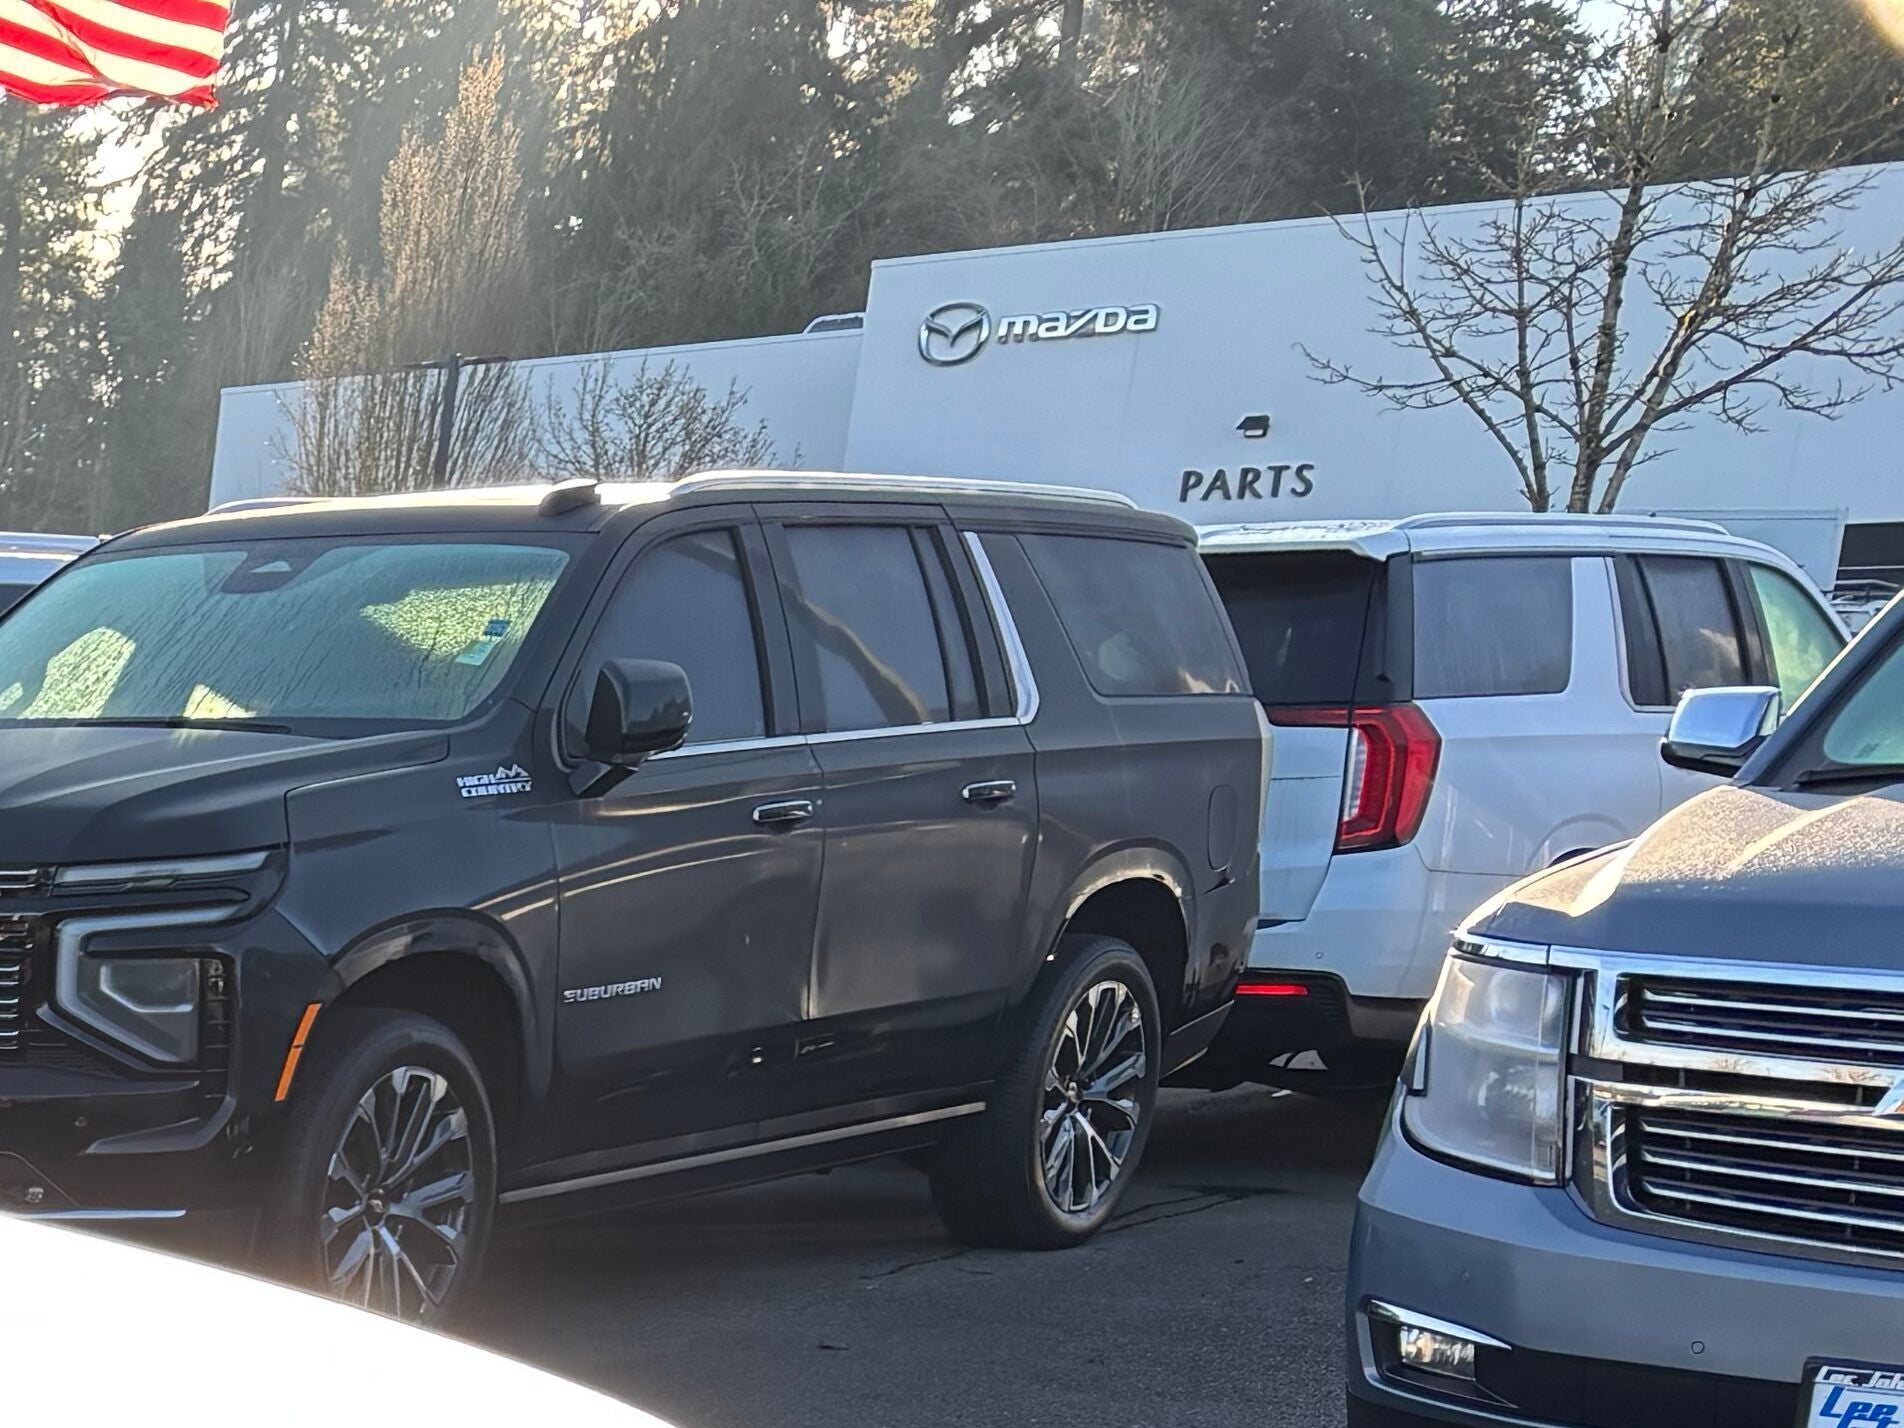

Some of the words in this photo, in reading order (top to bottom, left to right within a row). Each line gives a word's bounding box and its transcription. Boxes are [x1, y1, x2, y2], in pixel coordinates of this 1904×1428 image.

[1179, 463, 1316, 503] PARTS
[461, 781, 533, 798] COUNTRY
[563, 976, 662, 1003] SUBURBAN
[1818, 1384, 1900, 1424] Lee
